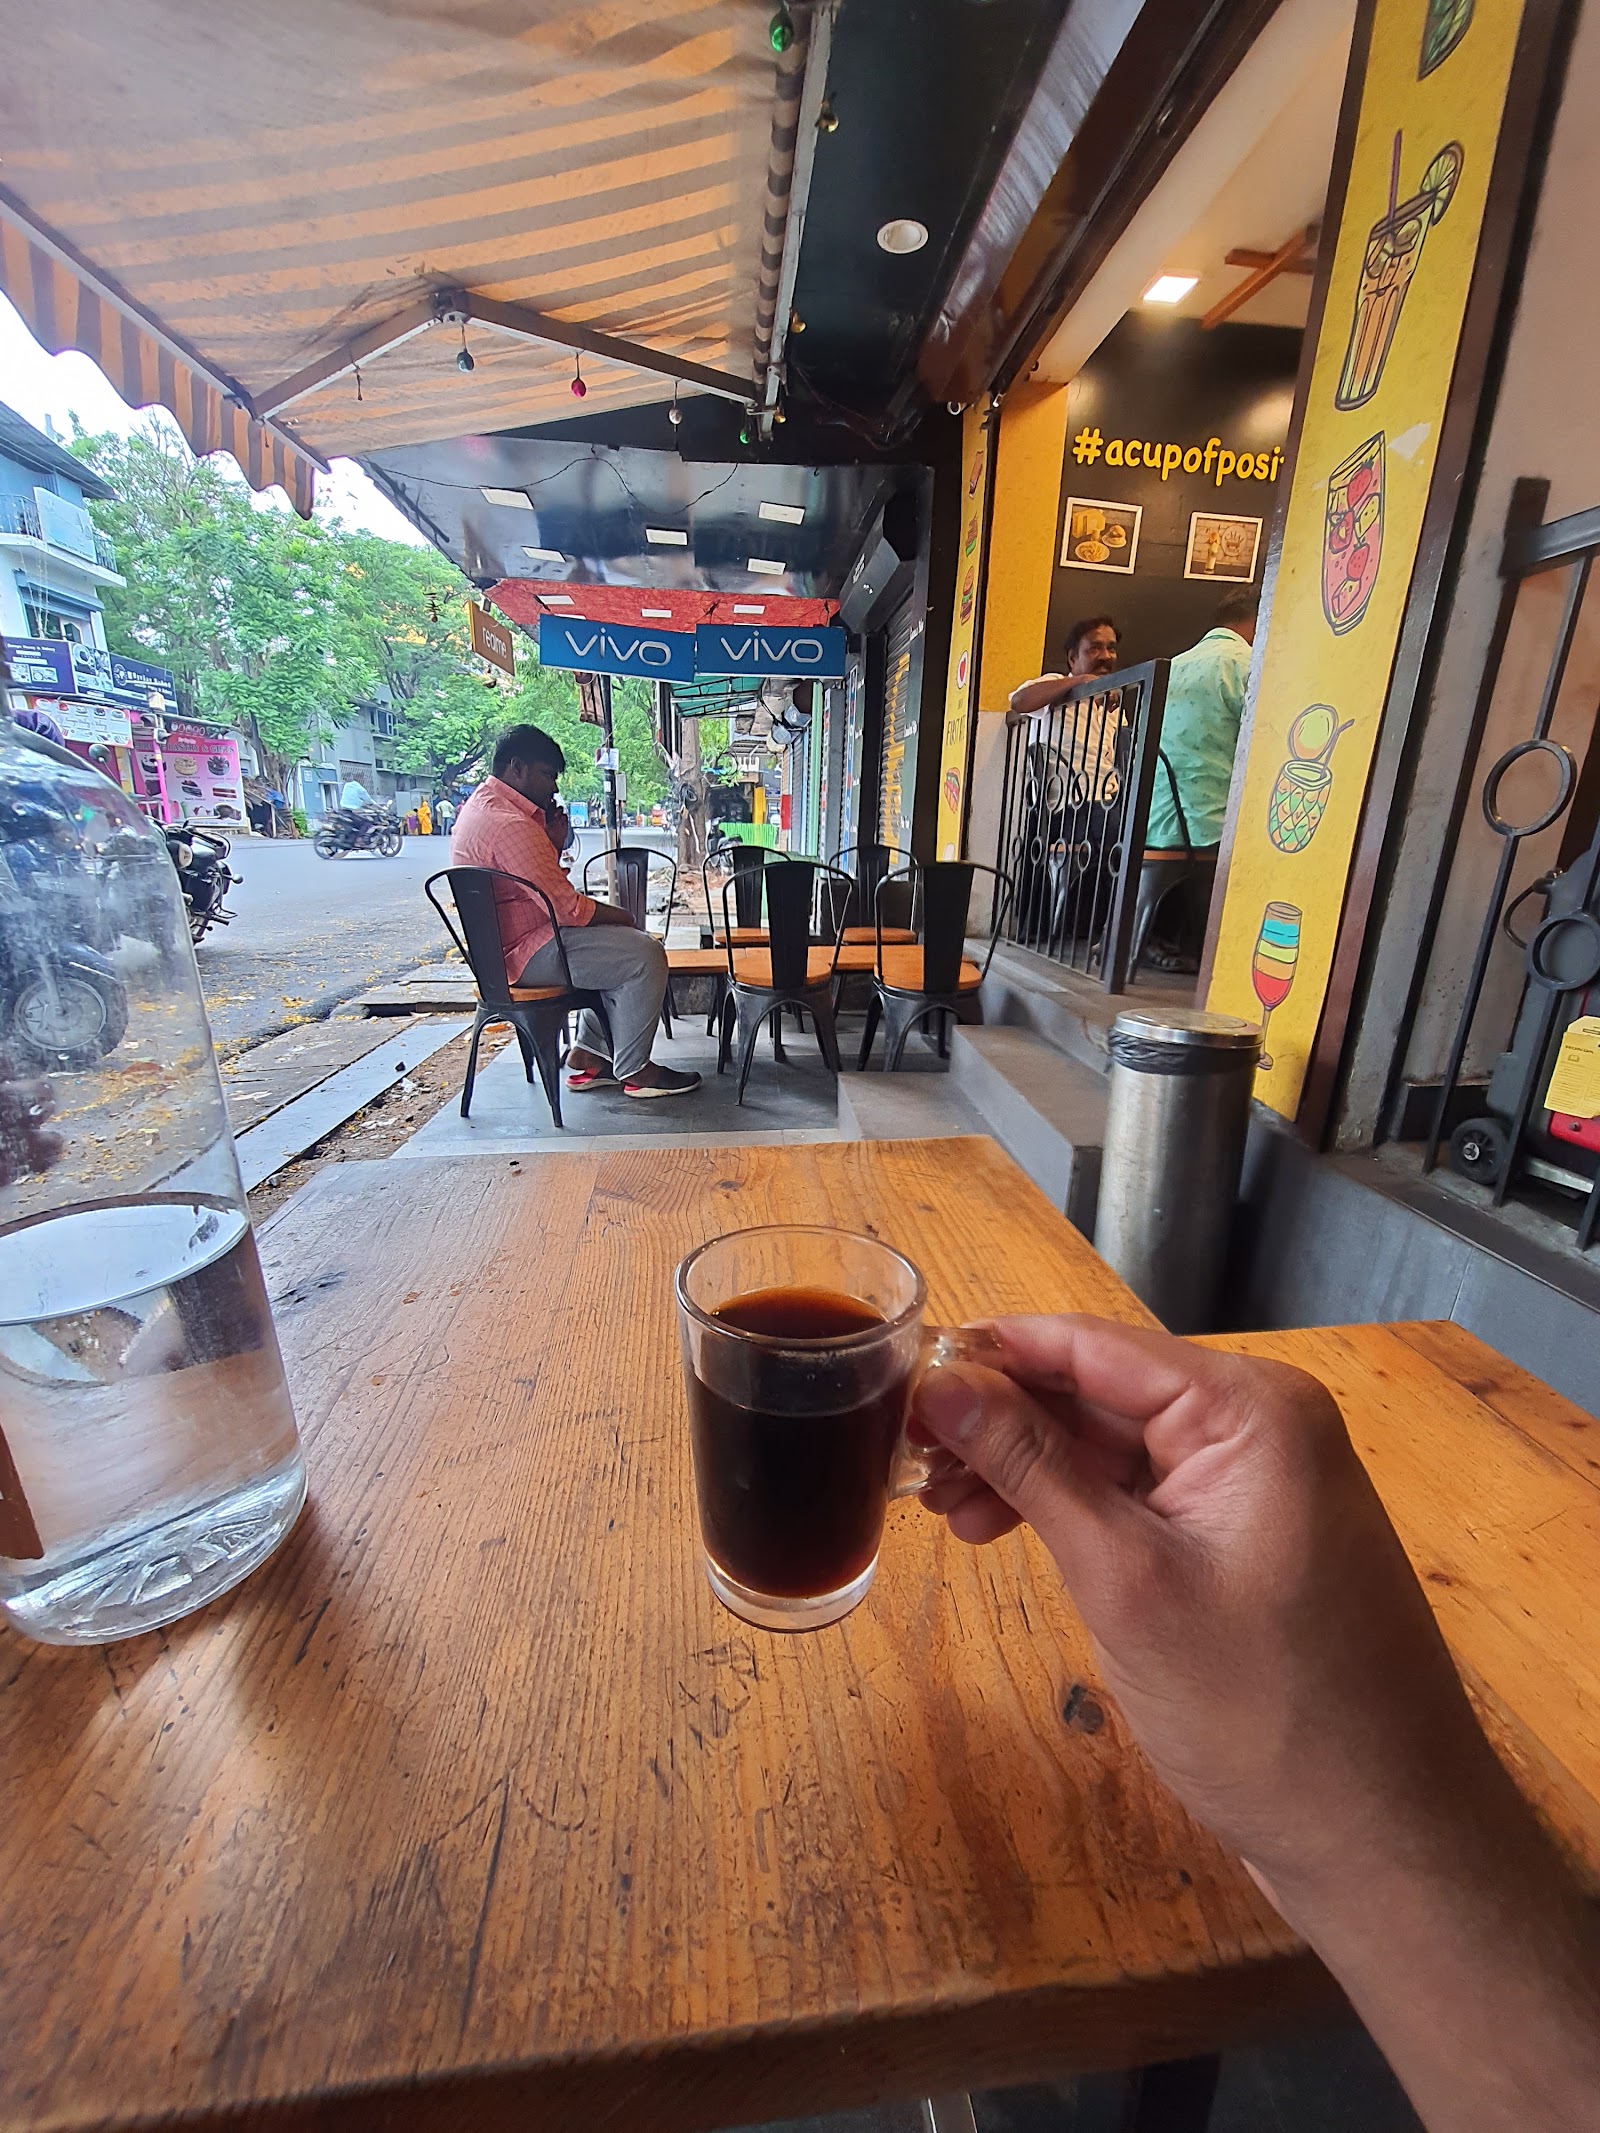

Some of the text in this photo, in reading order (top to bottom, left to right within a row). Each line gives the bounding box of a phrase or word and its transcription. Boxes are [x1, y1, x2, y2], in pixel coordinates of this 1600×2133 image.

[1072, 426, 1285, 487] #acupofposi
[565, 627, 672, 667] vivo
[720, 629, 824, 664] vivo
